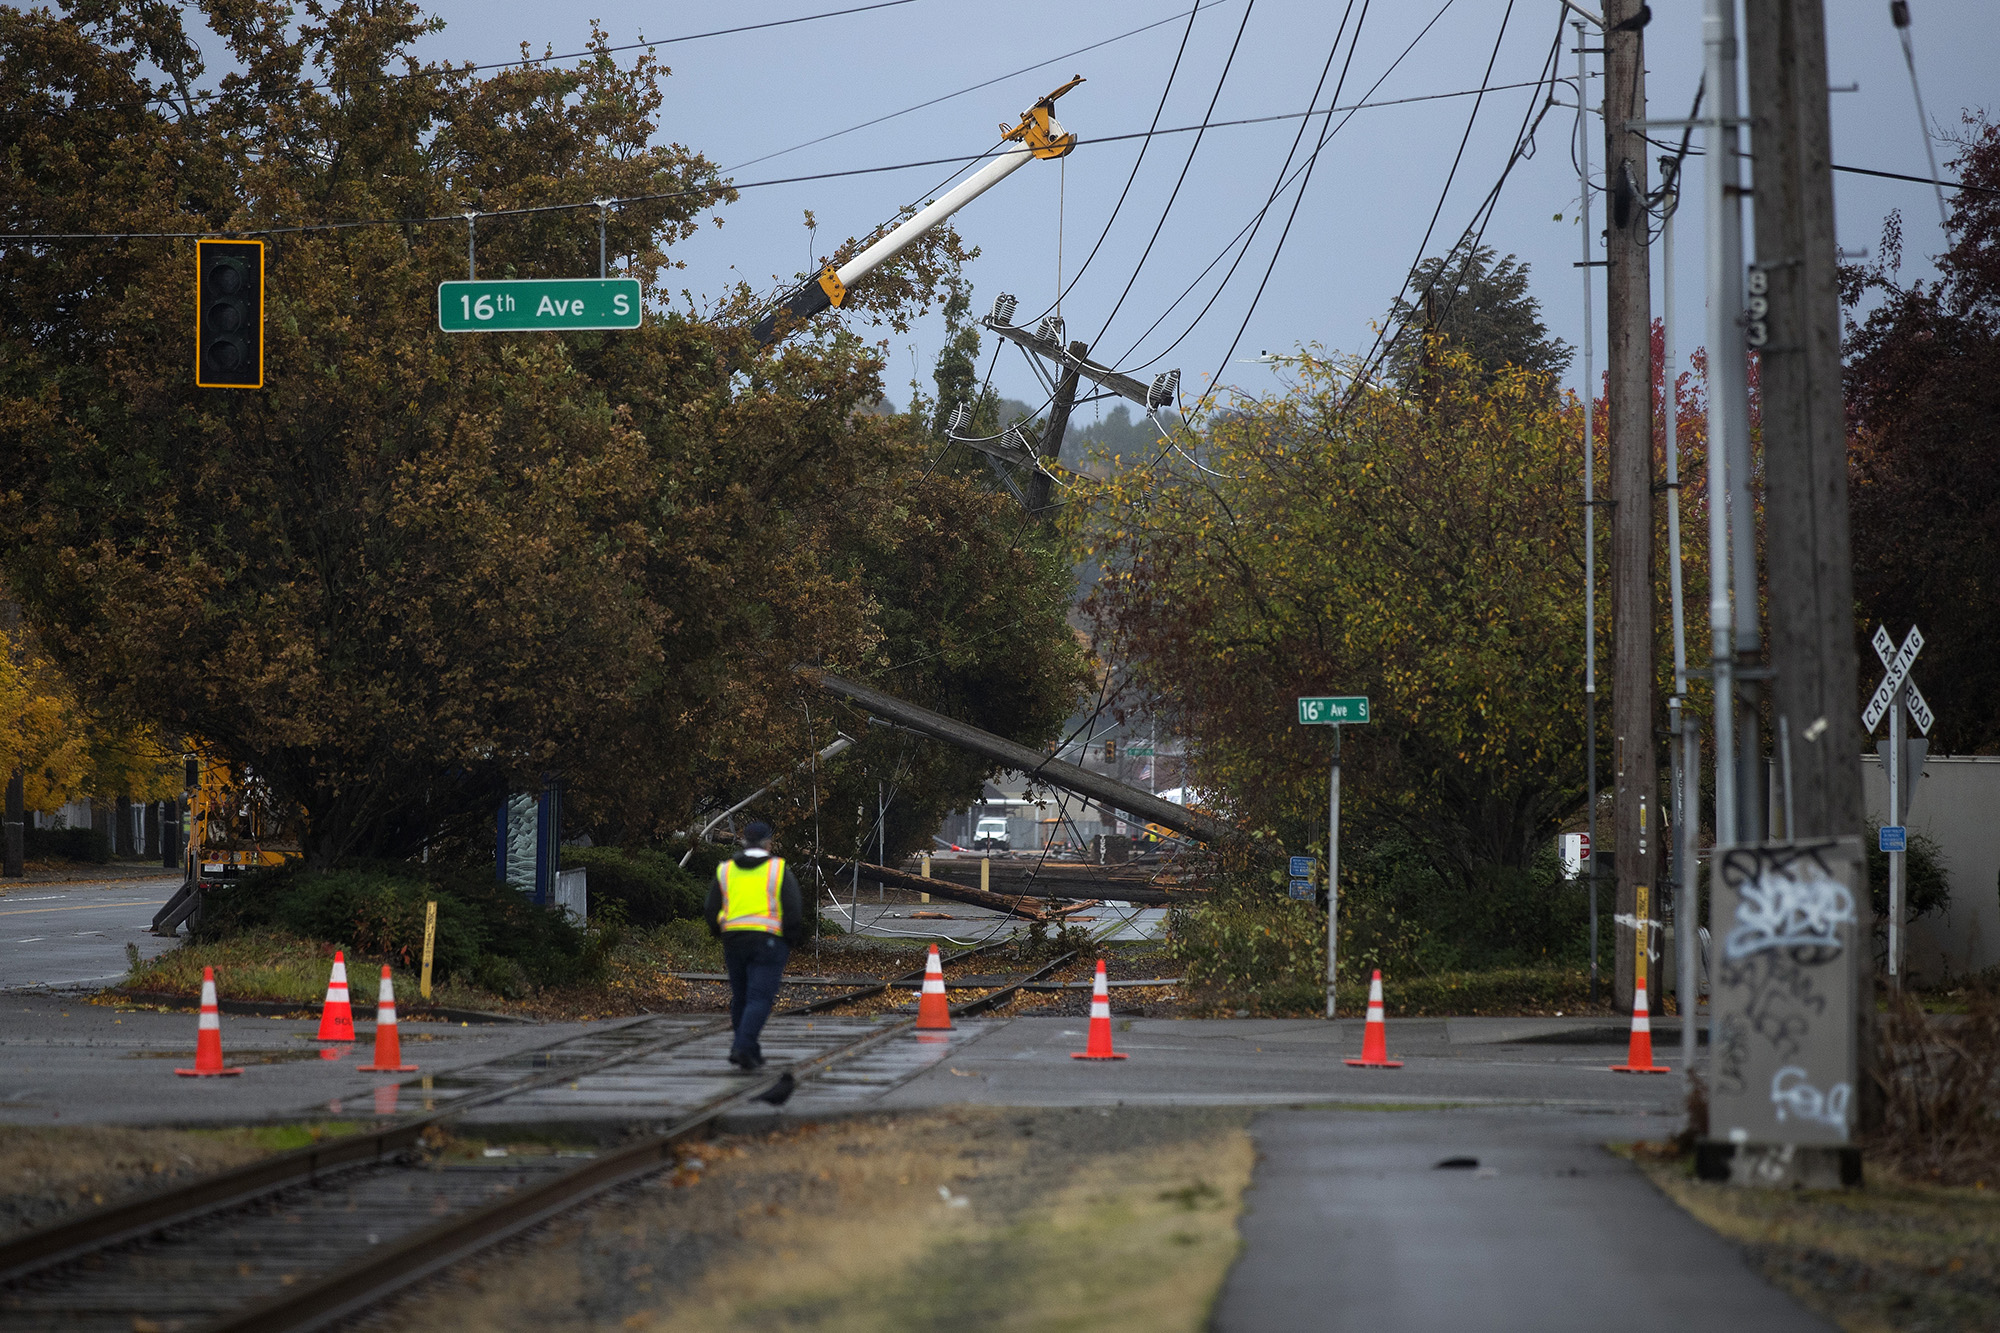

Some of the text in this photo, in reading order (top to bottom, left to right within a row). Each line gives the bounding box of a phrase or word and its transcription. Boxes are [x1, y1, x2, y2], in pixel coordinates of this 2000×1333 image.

[460, 294, 630, 321] 16th Ave S
[1748, 270, 1768, 346] 893
[1866, 633, 1920, 727] CROSSING
[1302, 701, 1366, 720] 16th Ave S
[1905, 685, 1930, 729] ROAD
